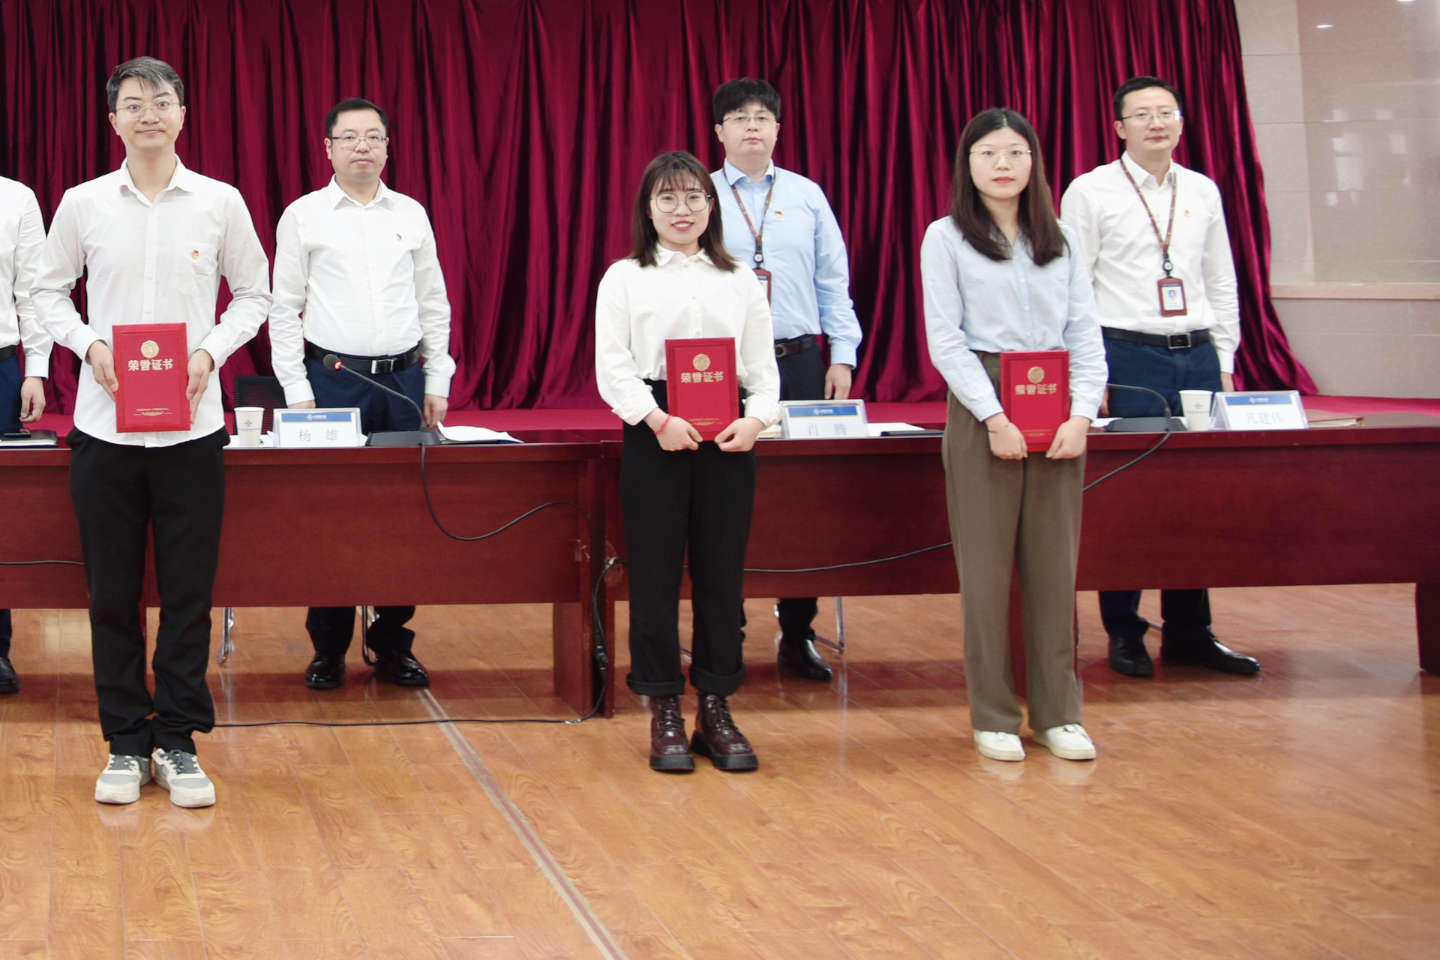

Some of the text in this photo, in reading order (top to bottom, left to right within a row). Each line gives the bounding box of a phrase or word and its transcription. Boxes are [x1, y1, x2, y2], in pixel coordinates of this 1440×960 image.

[127, 358, 174, 372] 荣誉证书
[680, 370, 725, 384] 荣誉证书
[1014, 383, 1058, 396] 荣誉证书
